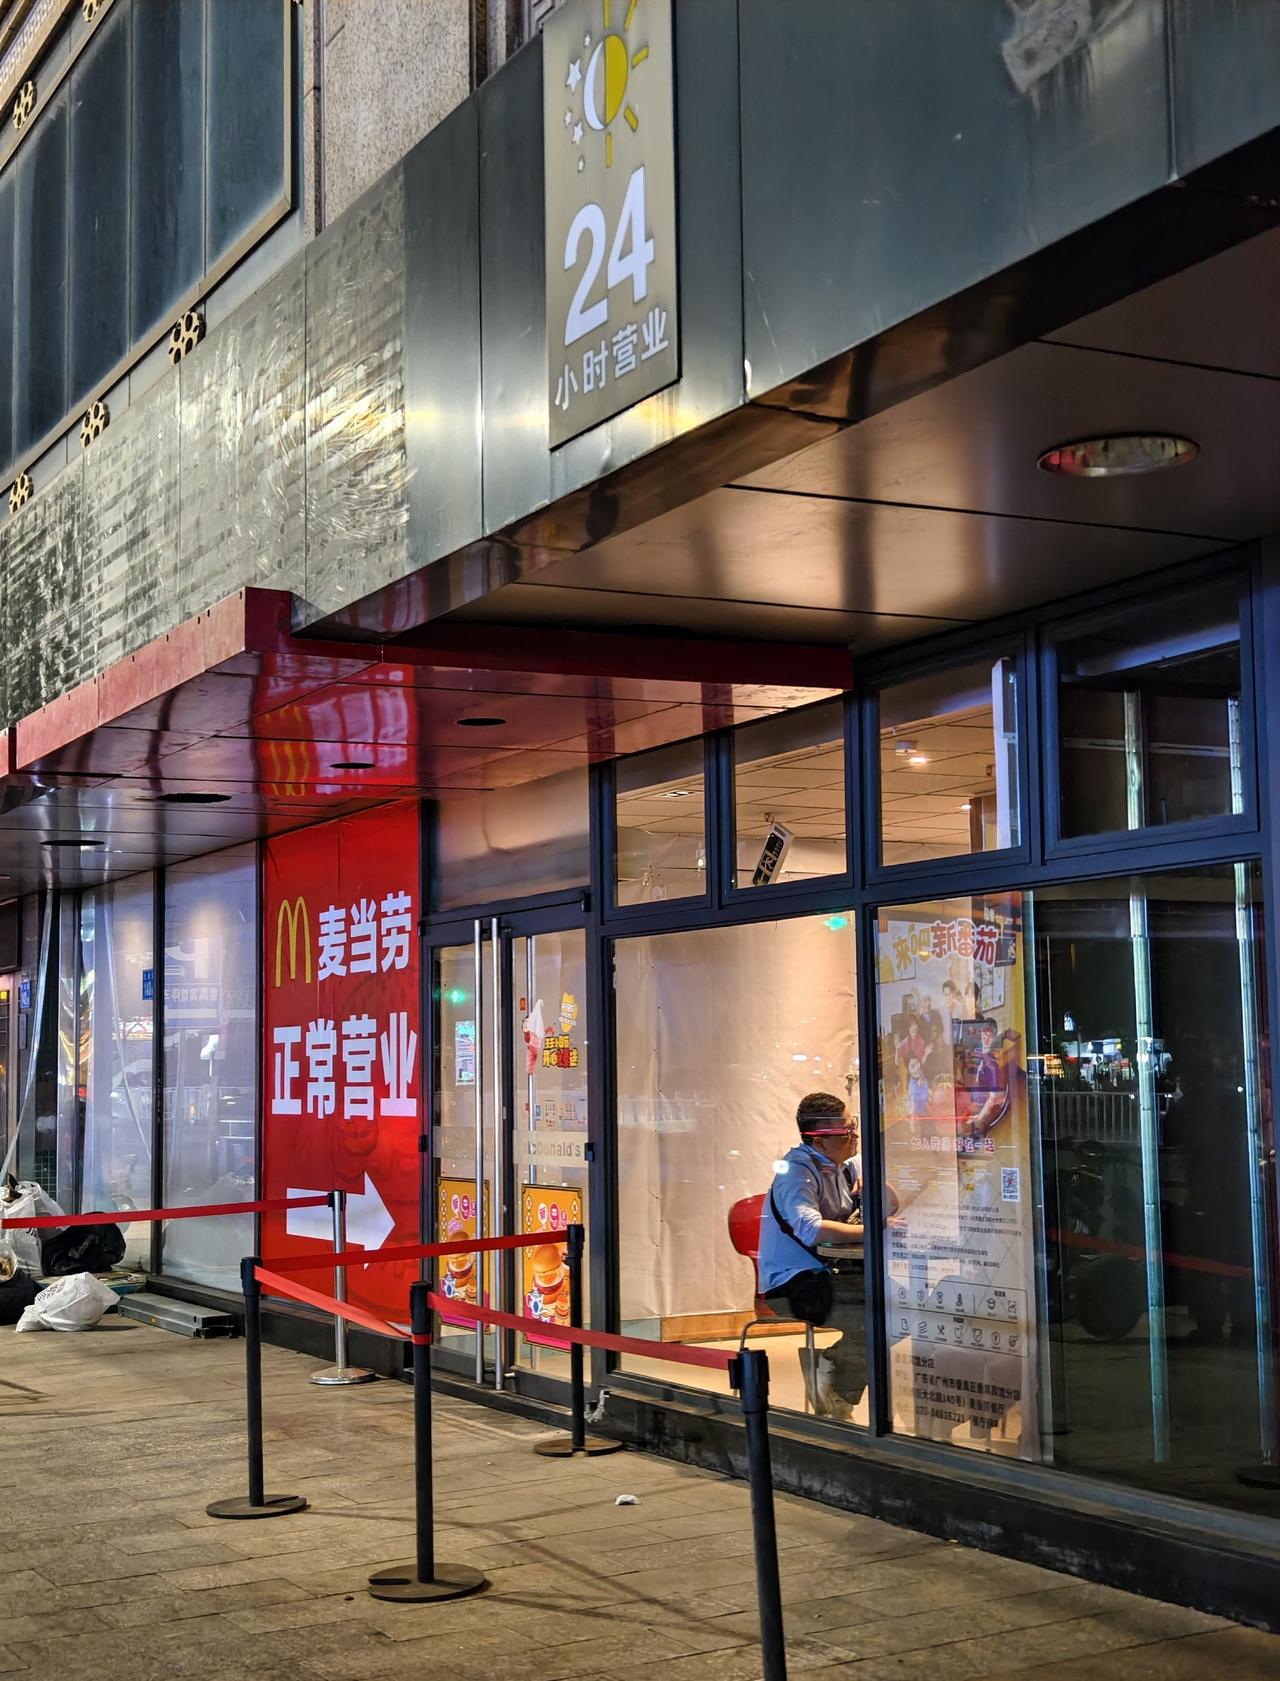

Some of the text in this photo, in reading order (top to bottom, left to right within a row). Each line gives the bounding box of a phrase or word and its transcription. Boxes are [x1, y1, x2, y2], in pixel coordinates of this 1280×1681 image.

[563, 165, 655, 347] 24
[555, 308, 669, 410] 小时营业
[318, 890, 412, 982] 麦当劳
[271, 1011, 418, 1121] 正常营业
